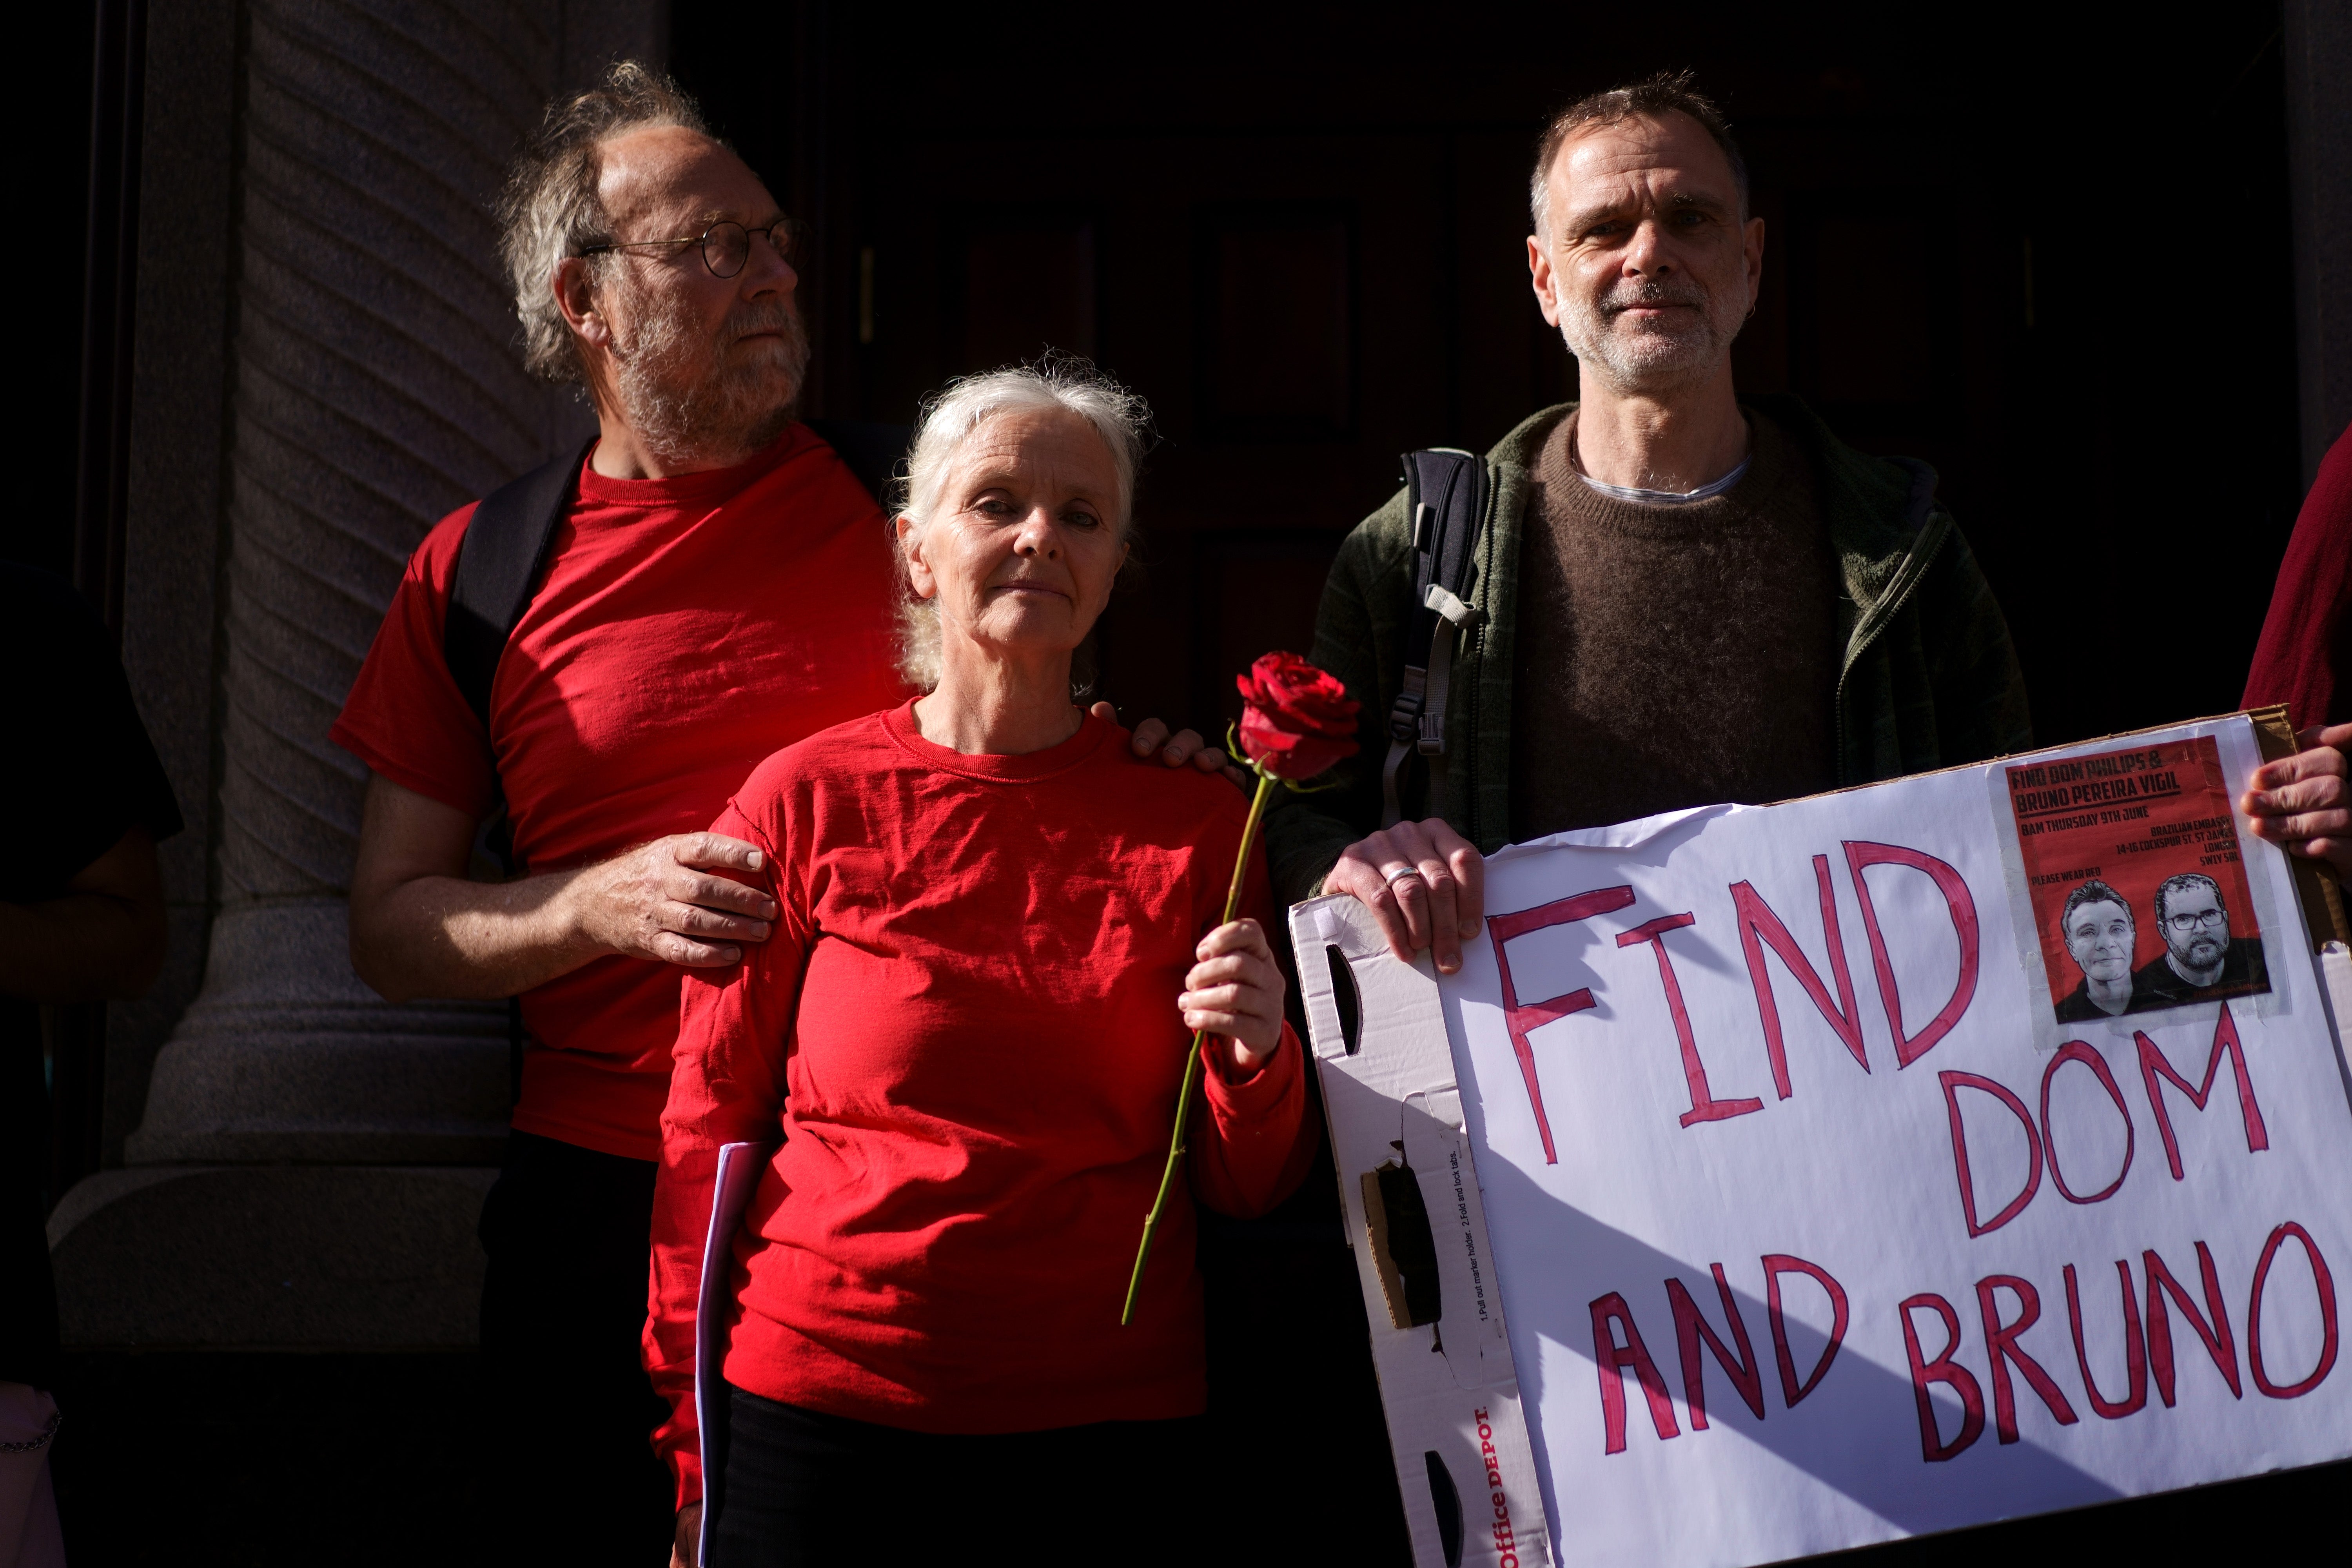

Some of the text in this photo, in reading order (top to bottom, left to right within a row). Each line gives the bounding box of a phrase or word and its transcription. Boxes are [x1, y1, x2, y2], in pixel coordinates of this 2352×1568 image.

[2011, 750, 2163, 790] FIND DOM PHILIPS &
[2015, 771, 2180, 813] BRUNO PEREIRA VIGIL
[2022, 806, 2149, 836] 8AM THURSDAY 9TH JUNE
[2150, 815, 2231, 837] BRAZILIAN EMBASSY
[2116, 843, 2138, 855] 14-16
[2139, 836, 2181, 851] COCKSPUR
[2195, 832, 2205, 842] ST
[2204, 839, 2237, 853] LONDON
[2031, 867, 2101, 886] PLEASE WEAR RED
[1485, 840, 1979, 1165] FIND
[1939, 1000, 2269, 1239] DOM
[1450, 1151, 1488, 1321] 1.Pull out marker holder. 2.Fold and lock tabs.
[1589, 1254, 1849, 1455] AND
[1899, 1221, 2337, 1463] BRUNO
[1492, 1491, 1519, 1568] Office
